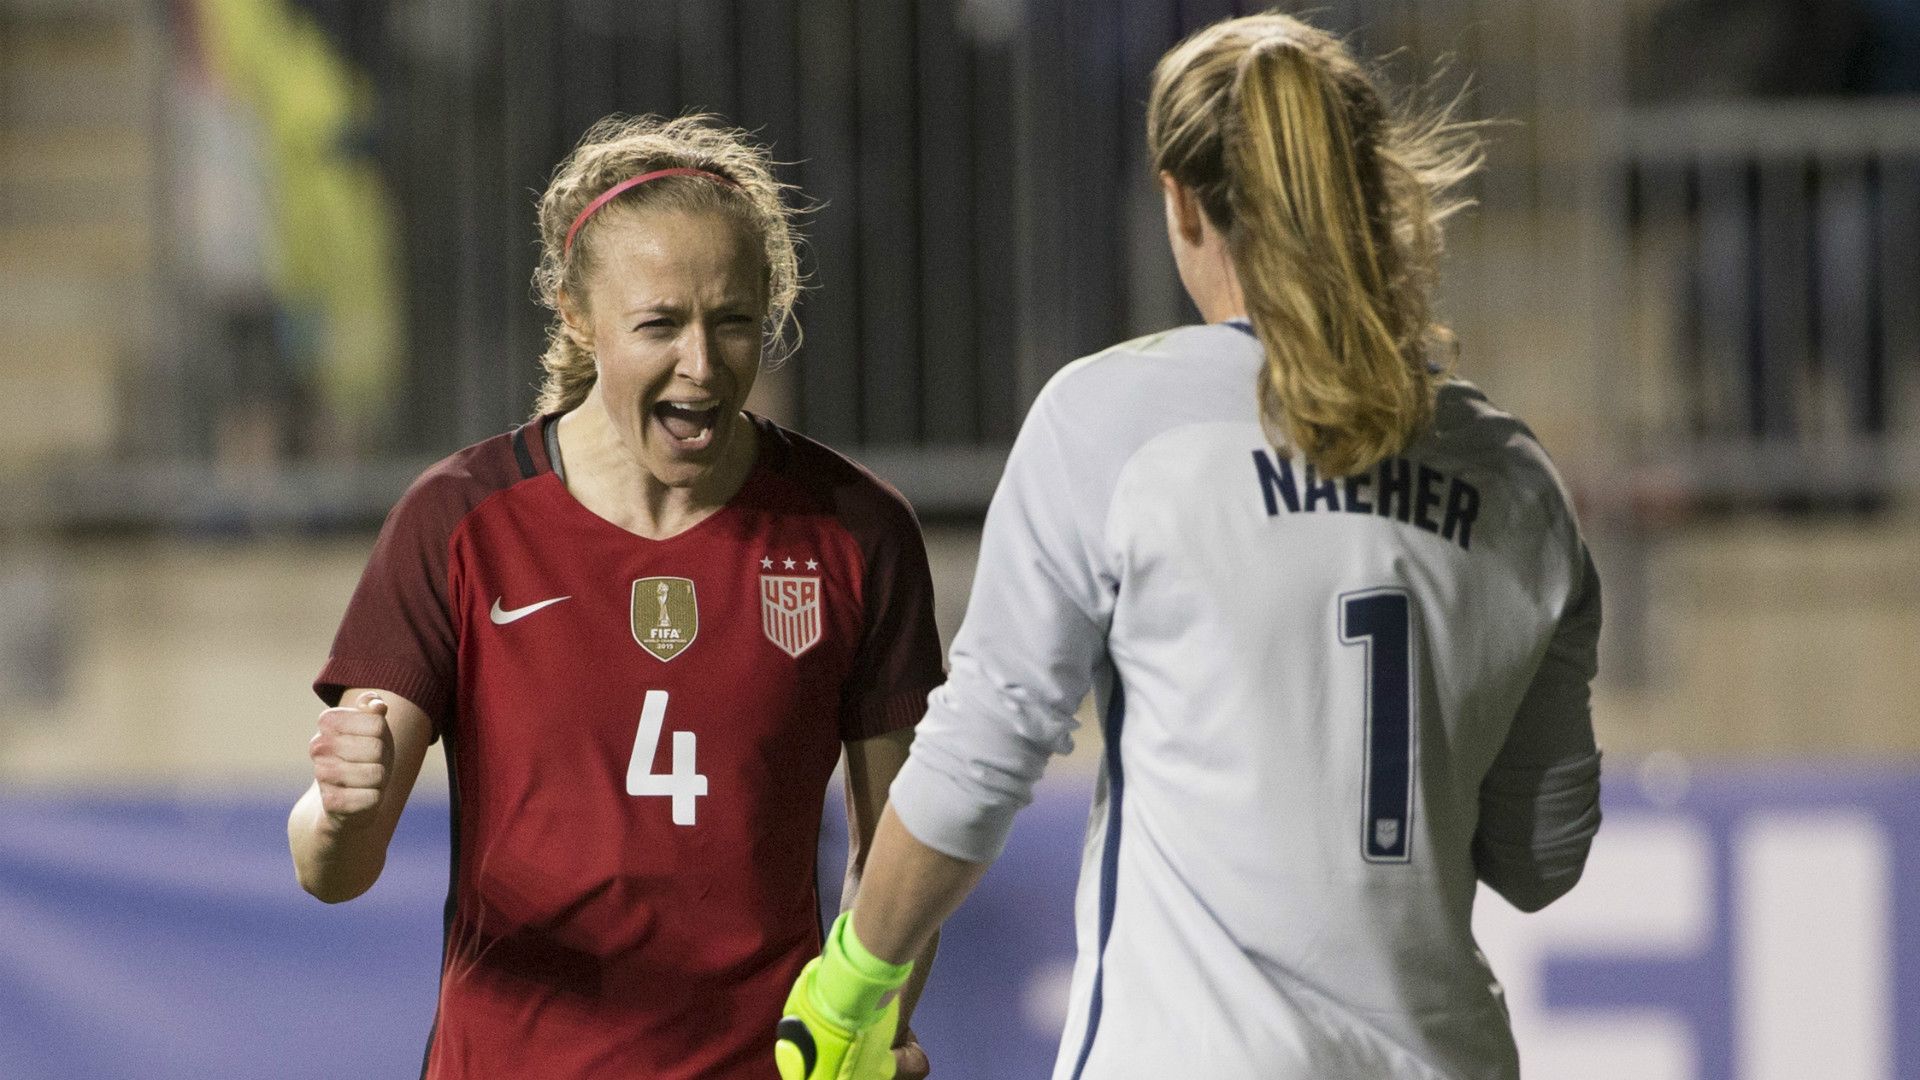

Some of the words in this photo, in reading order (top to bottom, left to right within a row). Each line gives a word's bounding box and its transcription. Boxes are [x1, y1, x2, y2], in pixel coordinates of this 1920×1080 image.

[1252, 449, 1480, 550] NAEHER
[650, 629, 679, 639] FIFA
[765, 580, 815, 611] USA
[626, 690, 708, 825] 4
[1339, 587, 1412, 863] 1
